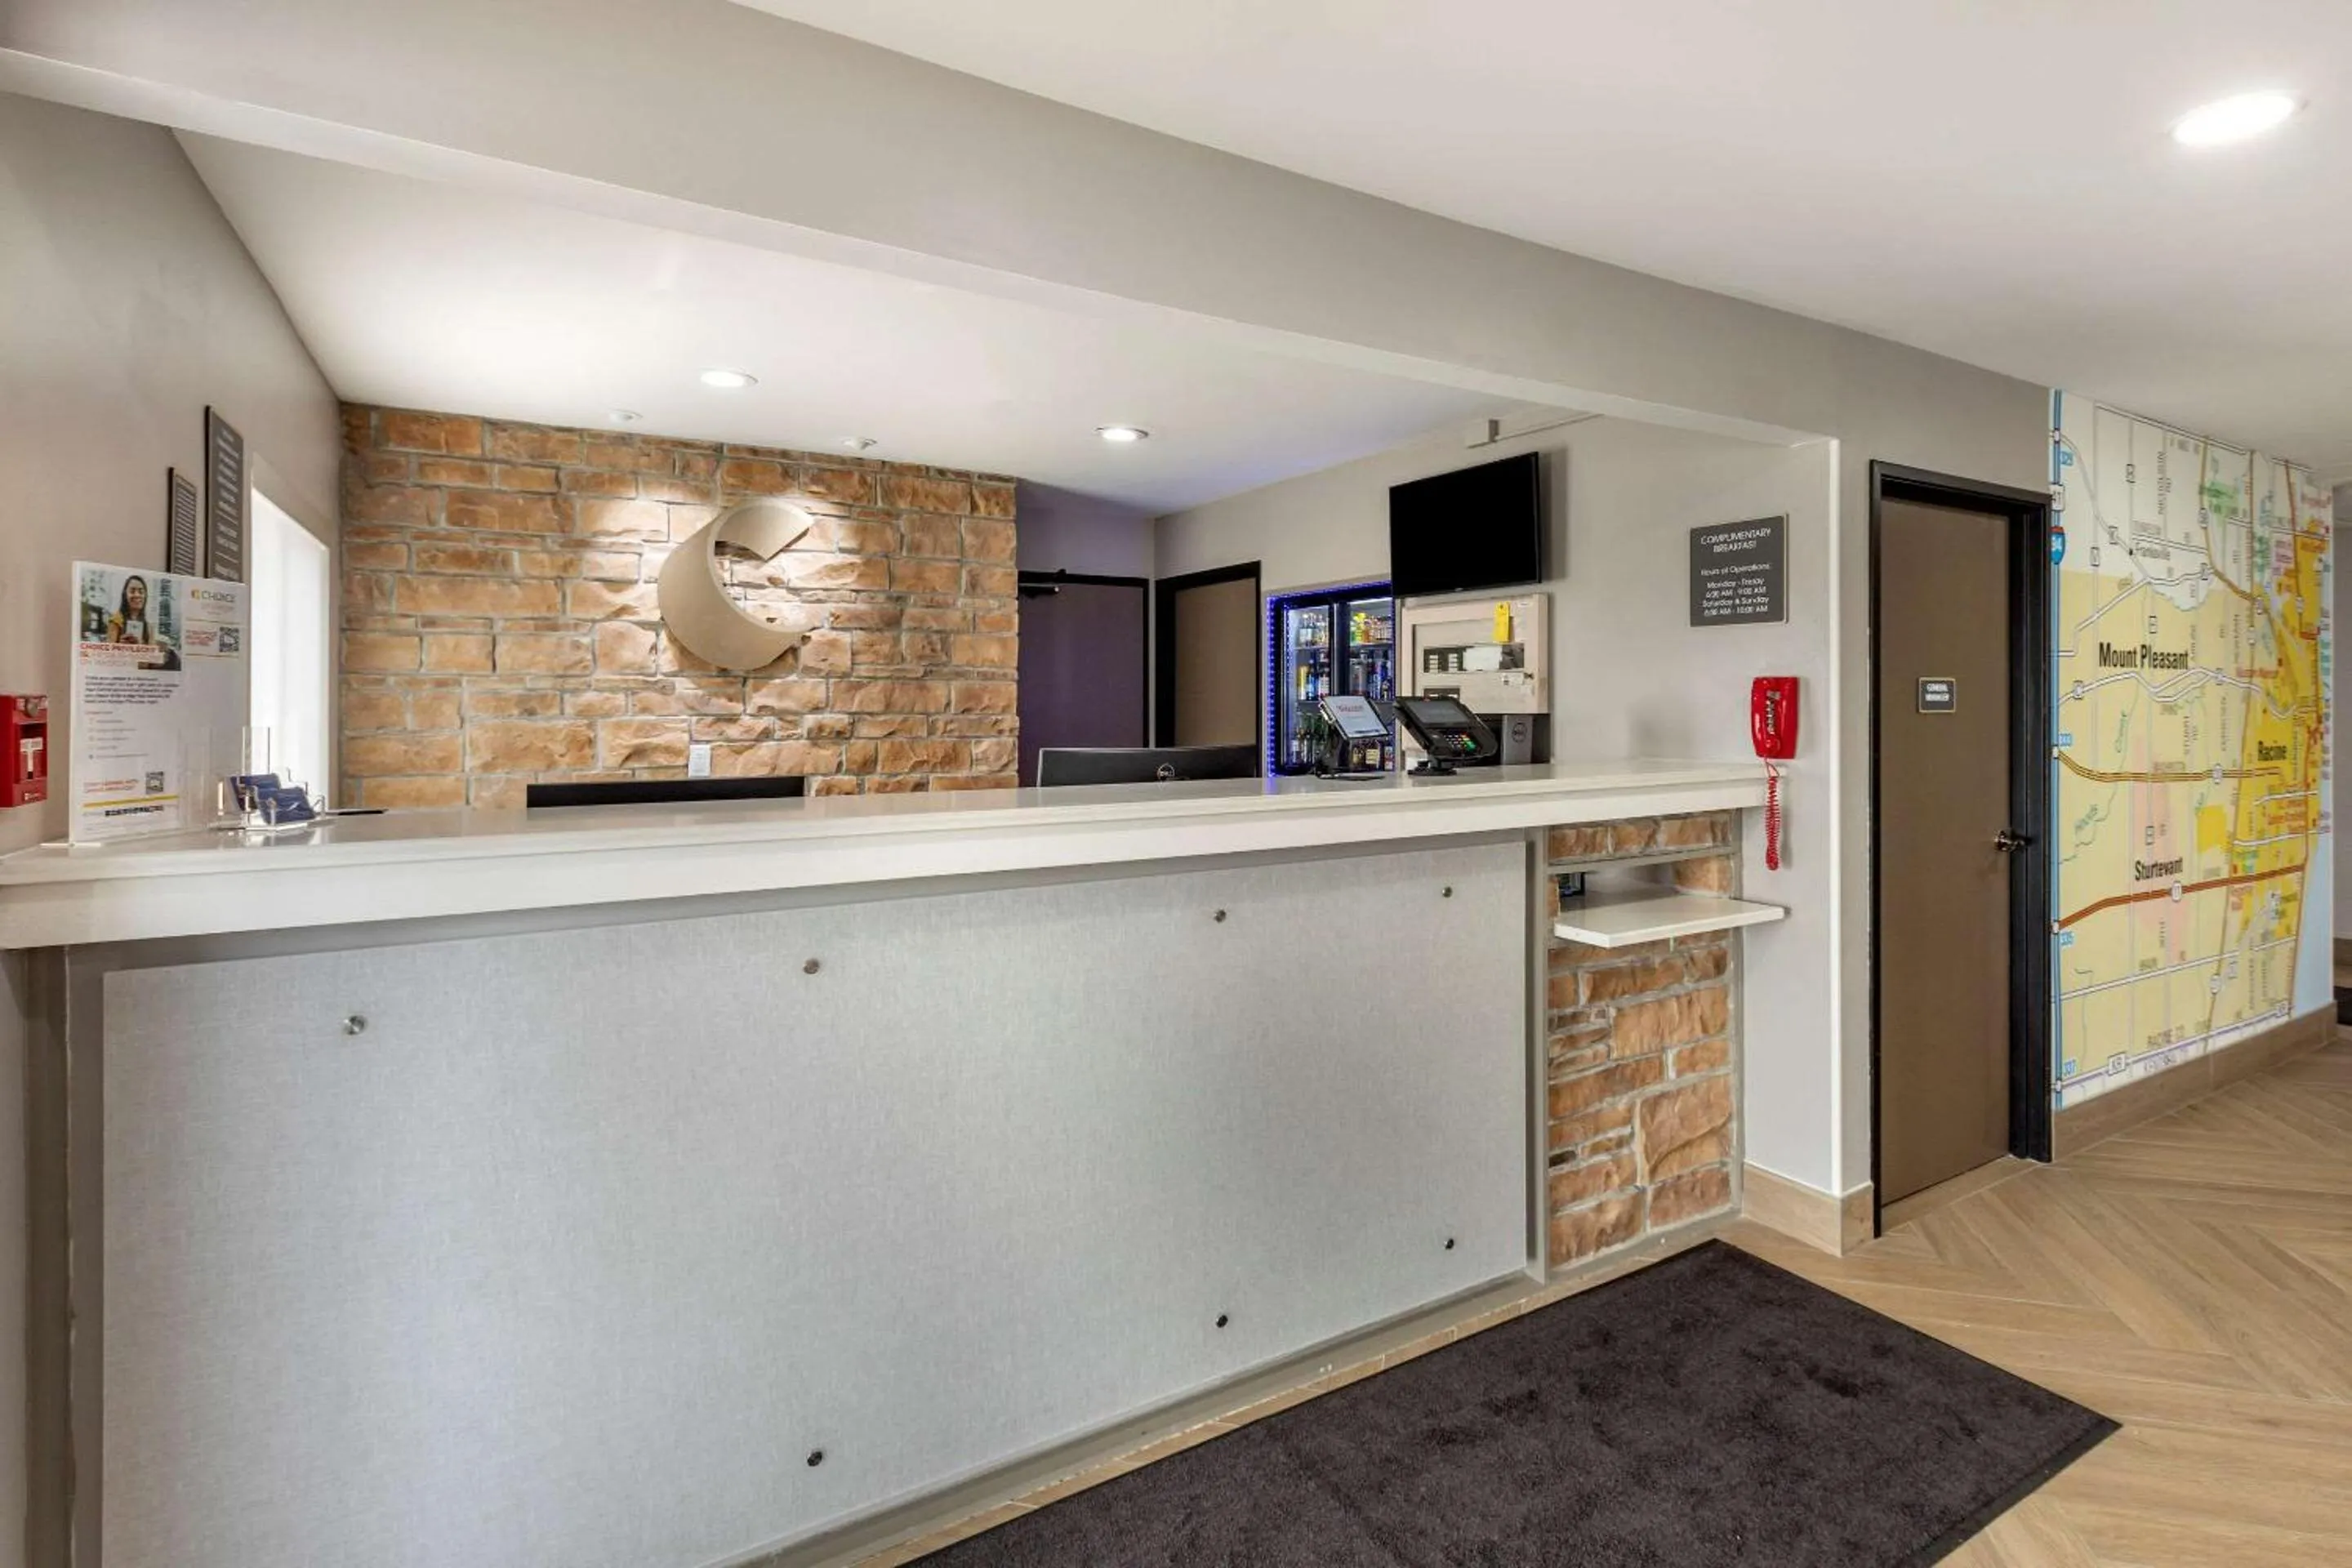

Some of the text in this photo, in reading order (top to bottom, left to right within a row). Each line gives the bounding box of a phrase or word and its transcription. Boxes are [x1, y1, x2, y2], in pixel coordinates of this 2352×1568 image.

[1700, 528, 1771, 545] COMPLIMENTARY
[1713, 540, 1757, 553] BREAKFAST
[2099, 641, 2138, 668] Mount
[2140, 644, 2189, 670] Pleasant
[2257, 739, 2287, 762] Racine
[2135, 857, 2184, 882] Sturtevant
